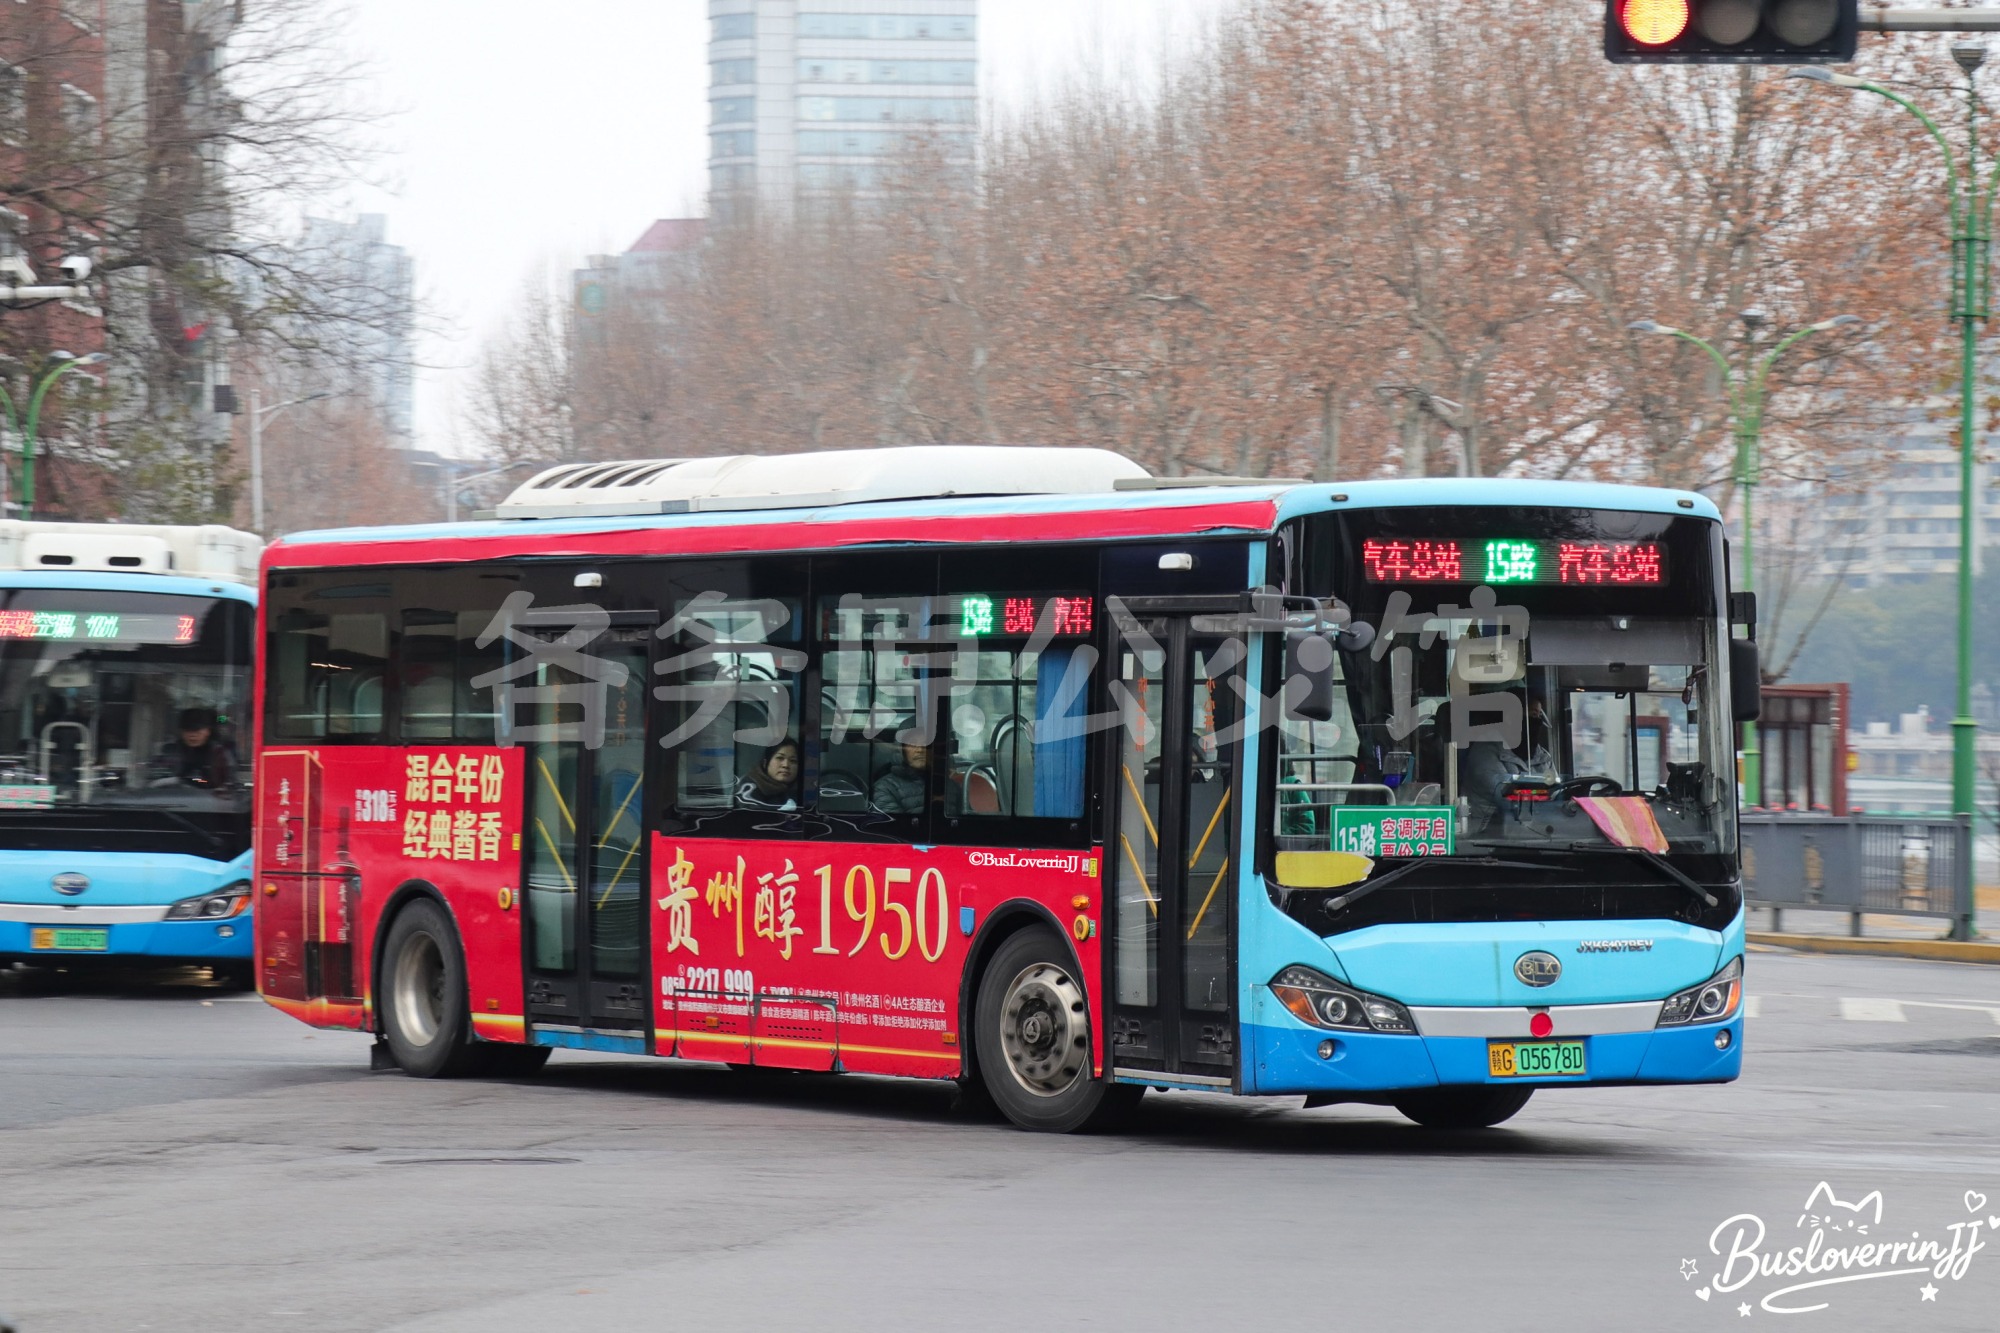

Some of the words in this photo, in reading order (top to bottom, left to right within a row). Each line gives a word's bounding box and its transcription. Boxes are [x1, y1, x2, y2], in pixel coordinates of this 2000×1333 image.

[1486, 542, 1536, 582] 15路
[1560, 543, 1660, 583] 汽车总站
[1004, 597, 1034, 632] 总站
[405, 753, 504, 804] 混合年份
[402, 809, 502, 861] 经典酱香
[1339, 823, 1376, 856] 15路
[1380, 817, 1447, 840] 空调开启
[687, 966, 719, 999] 2217
[724, 968, 753, 1002] 999
[1520, 1046, 1583, 1070] 05678D
